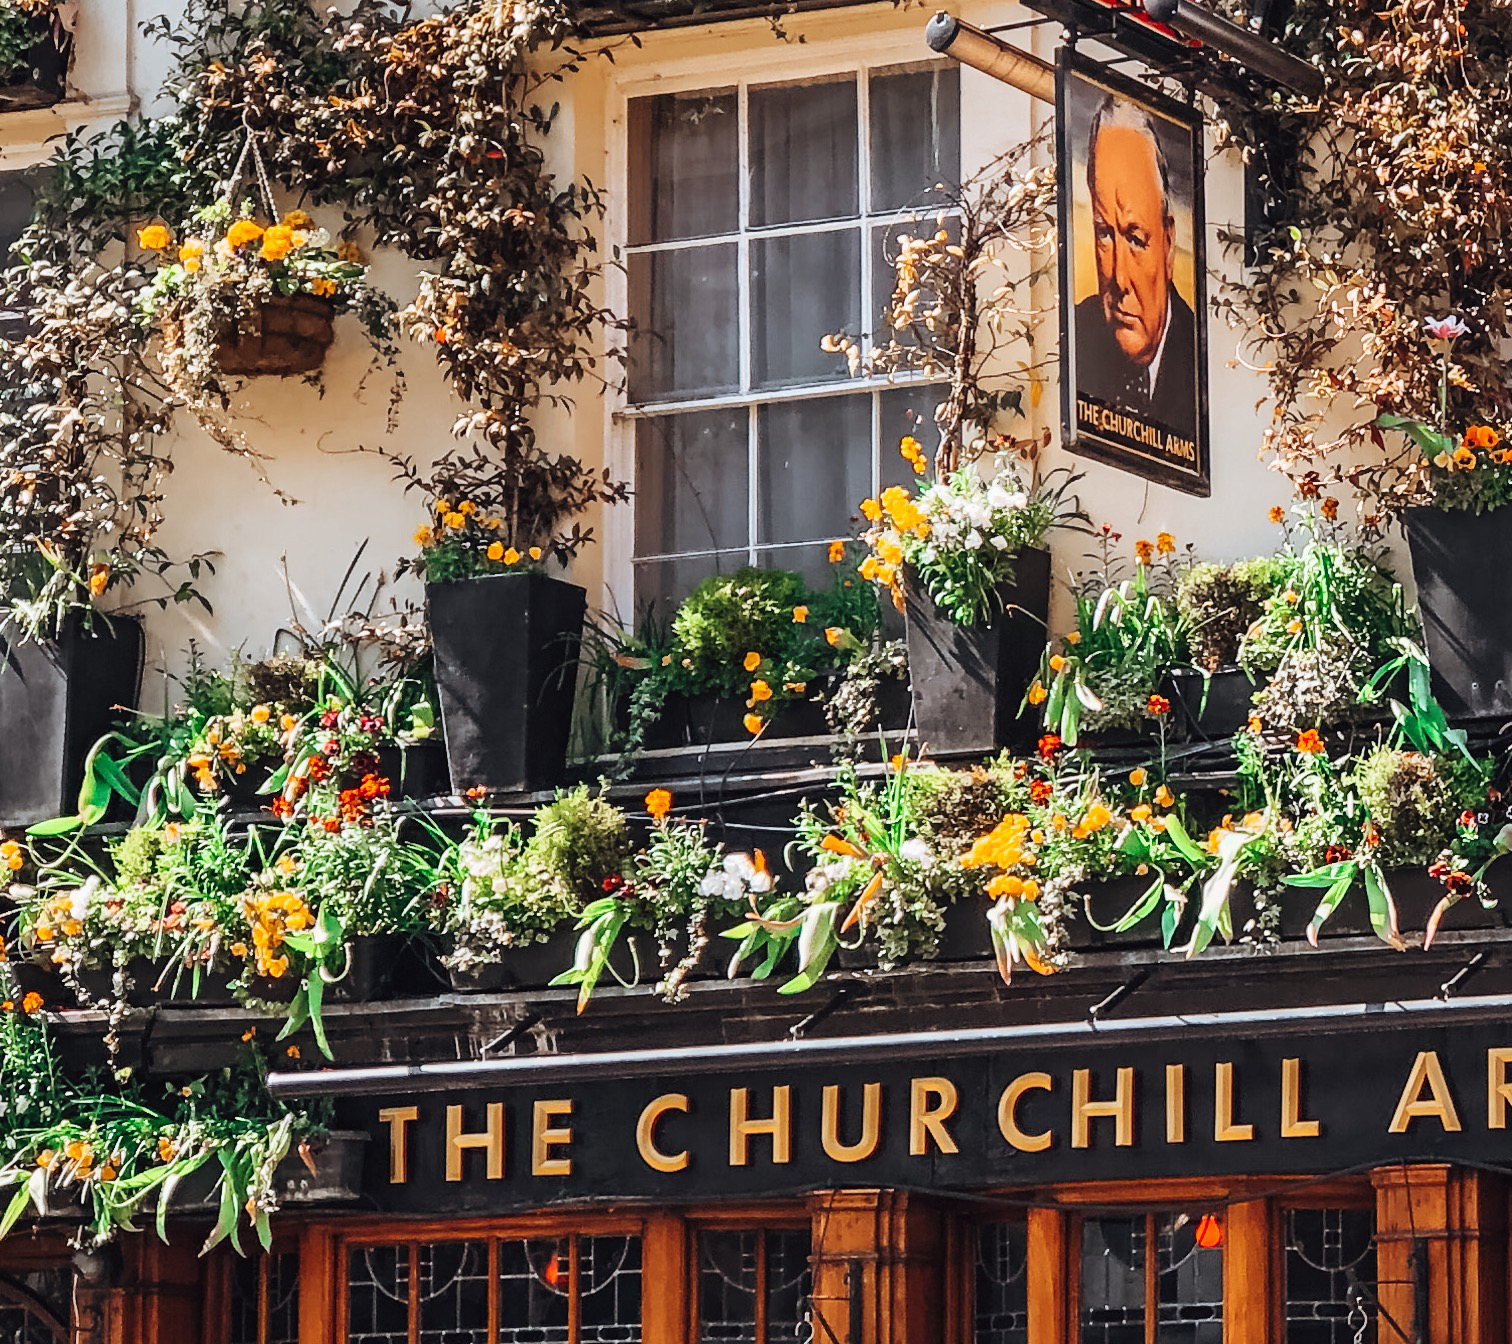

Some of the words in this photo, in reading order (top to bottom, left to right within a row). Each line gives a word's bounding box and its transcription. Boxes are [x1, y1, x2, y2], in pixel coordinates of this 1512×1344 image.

[1077, 399, 1099, 425] THE
[1101, 409, 1164, 450] CHURCHILL
[1165, 433, 1195, 462] ARMS
[378, 1098, 574, 1184] THE
[635, 1057, 1321, 1173] CHURCHILL
